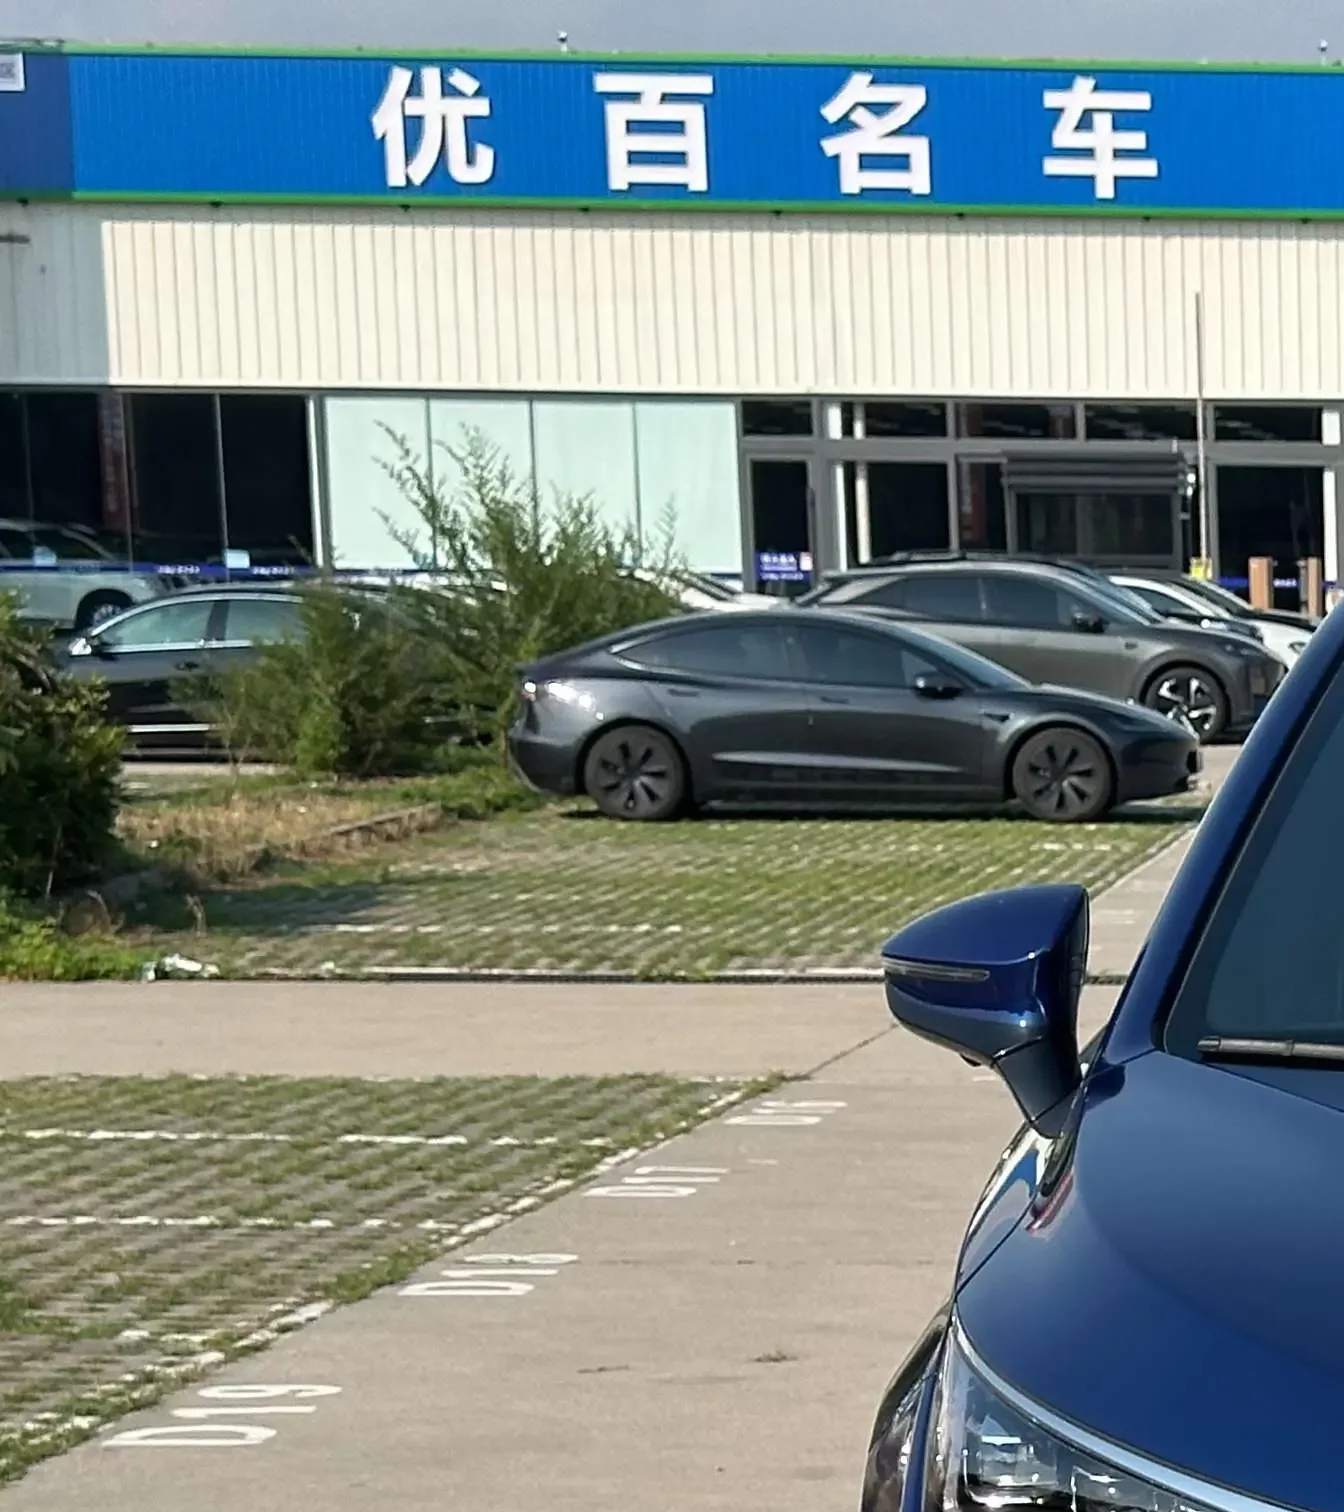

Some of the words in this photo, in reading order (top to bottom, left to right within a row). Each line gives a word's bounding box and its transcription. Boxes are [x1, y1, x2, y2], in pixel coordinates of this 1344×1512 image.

[371, 66, 1158, 199] 优百名车
[101, 1383, 343, 1448] D19
